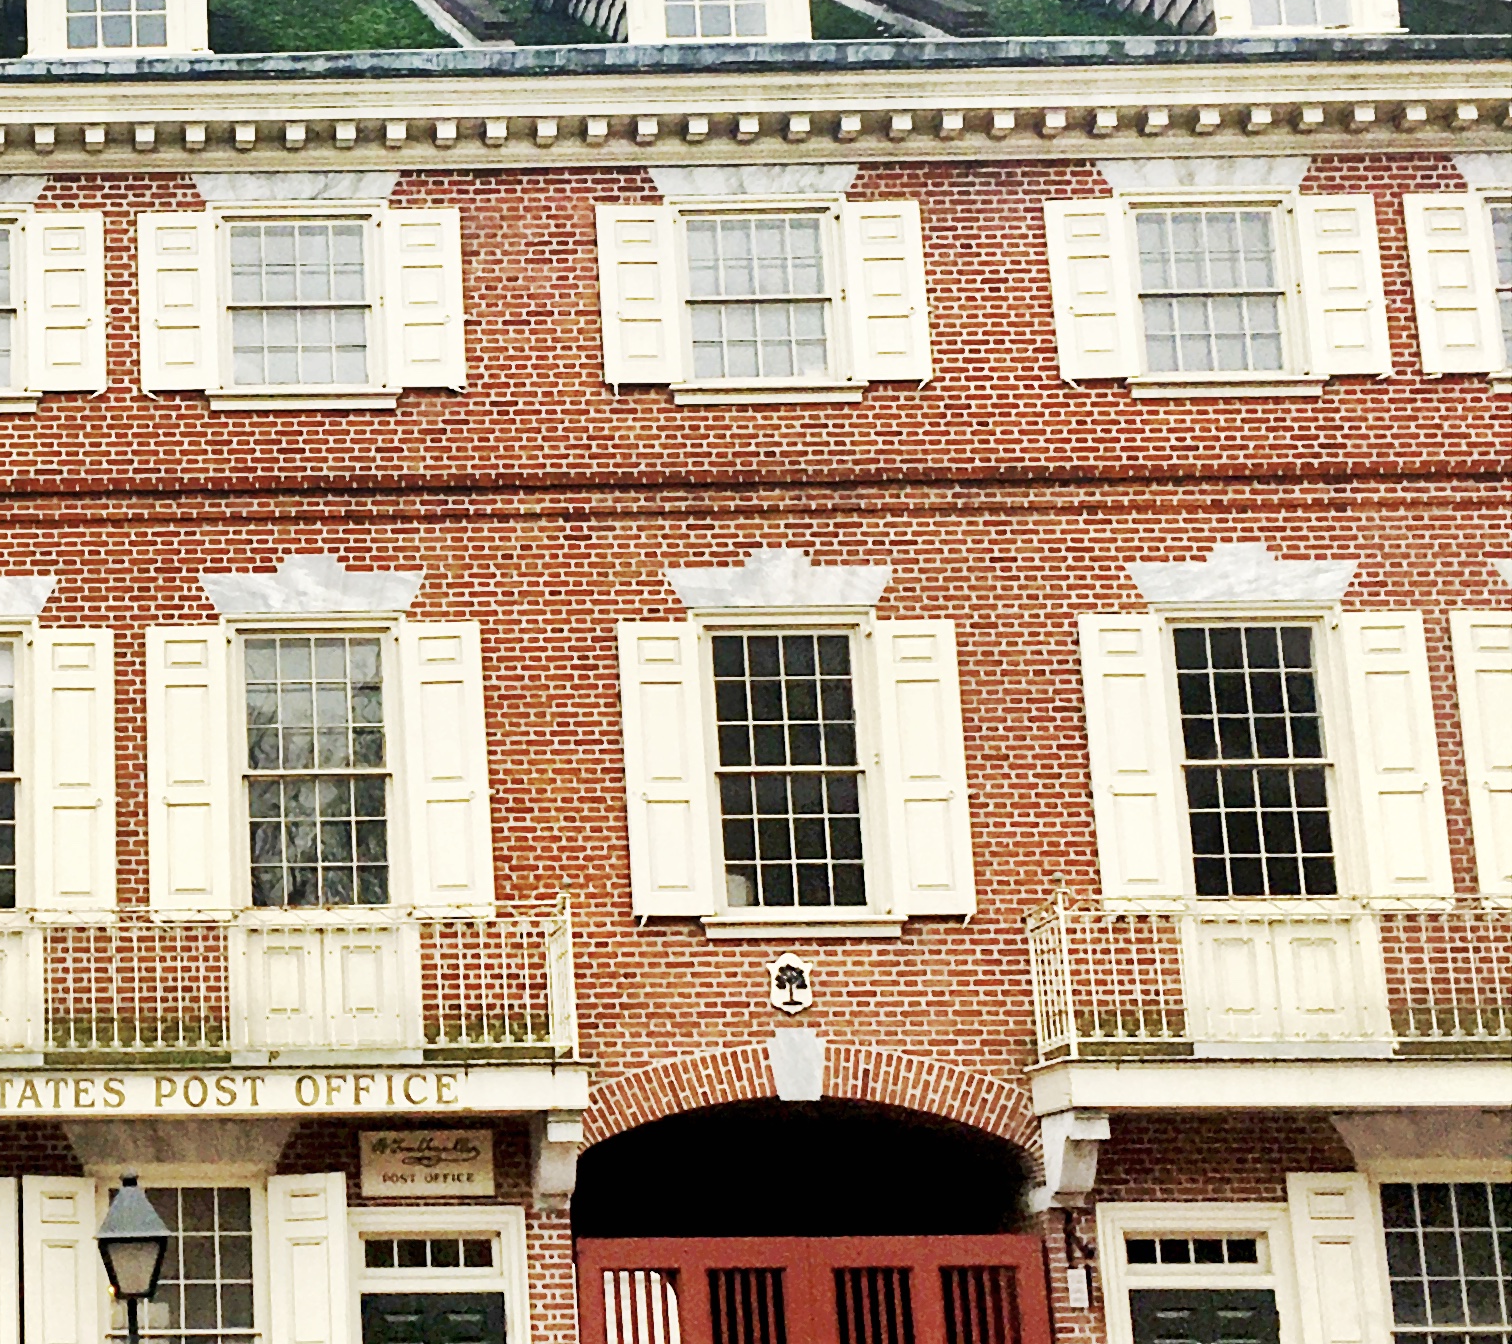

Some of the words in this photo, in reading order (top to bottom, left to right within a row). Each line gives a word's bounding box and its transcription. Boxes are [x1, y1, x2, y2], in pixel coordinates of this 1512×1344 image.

[154, 1074, 265, 1108] POST
[294, 1073, 459, 1107] OFFICE
[381, 1171, 416, 1184] POST
[424, 1171, 475, 1184] OFFICE
